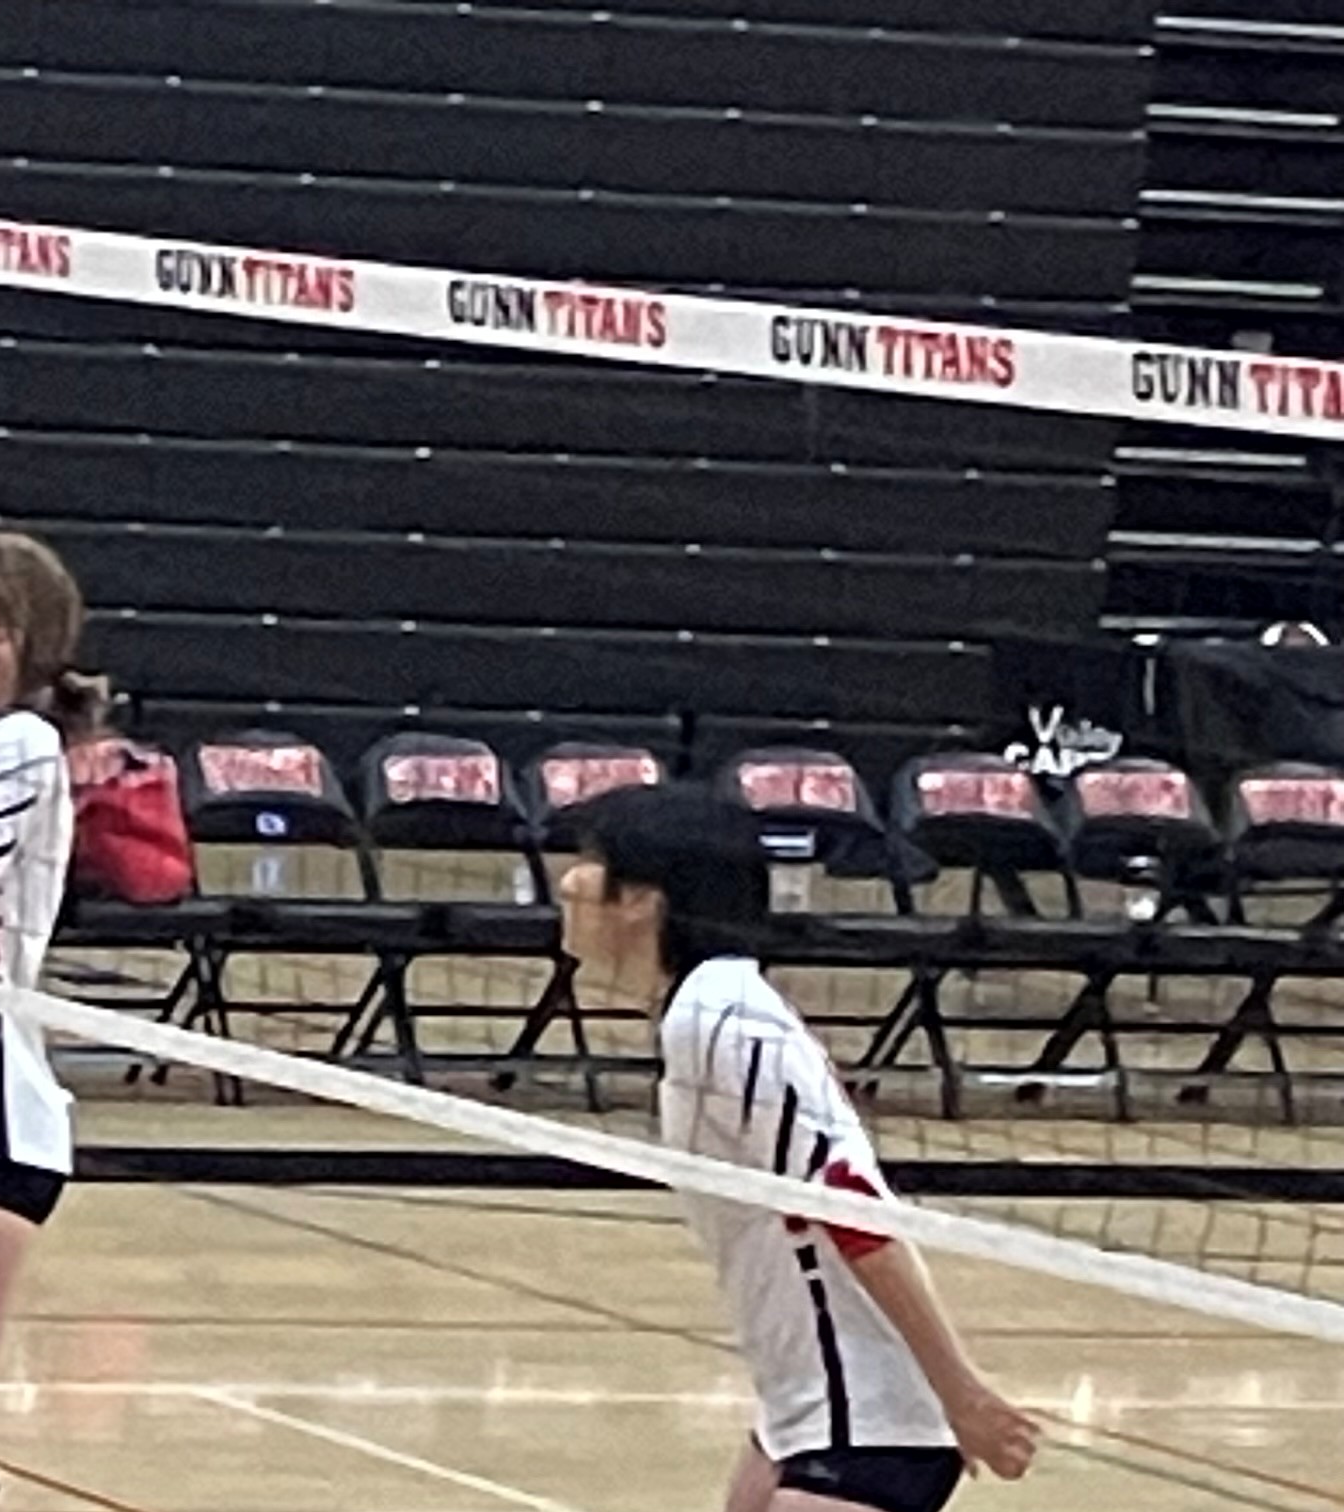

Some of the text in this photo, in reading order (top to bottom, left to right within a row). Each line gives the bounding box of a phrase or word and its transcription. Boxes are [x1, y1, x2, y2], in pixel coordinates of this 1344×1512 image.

[155, 248, 355, 313] GUNN TITANS
[448, 280, 667, 347] GUNN TITANS
[771, 315, 1015, 388] GUNN TITANS
[1132, 350, 1240, 409] GUNN
